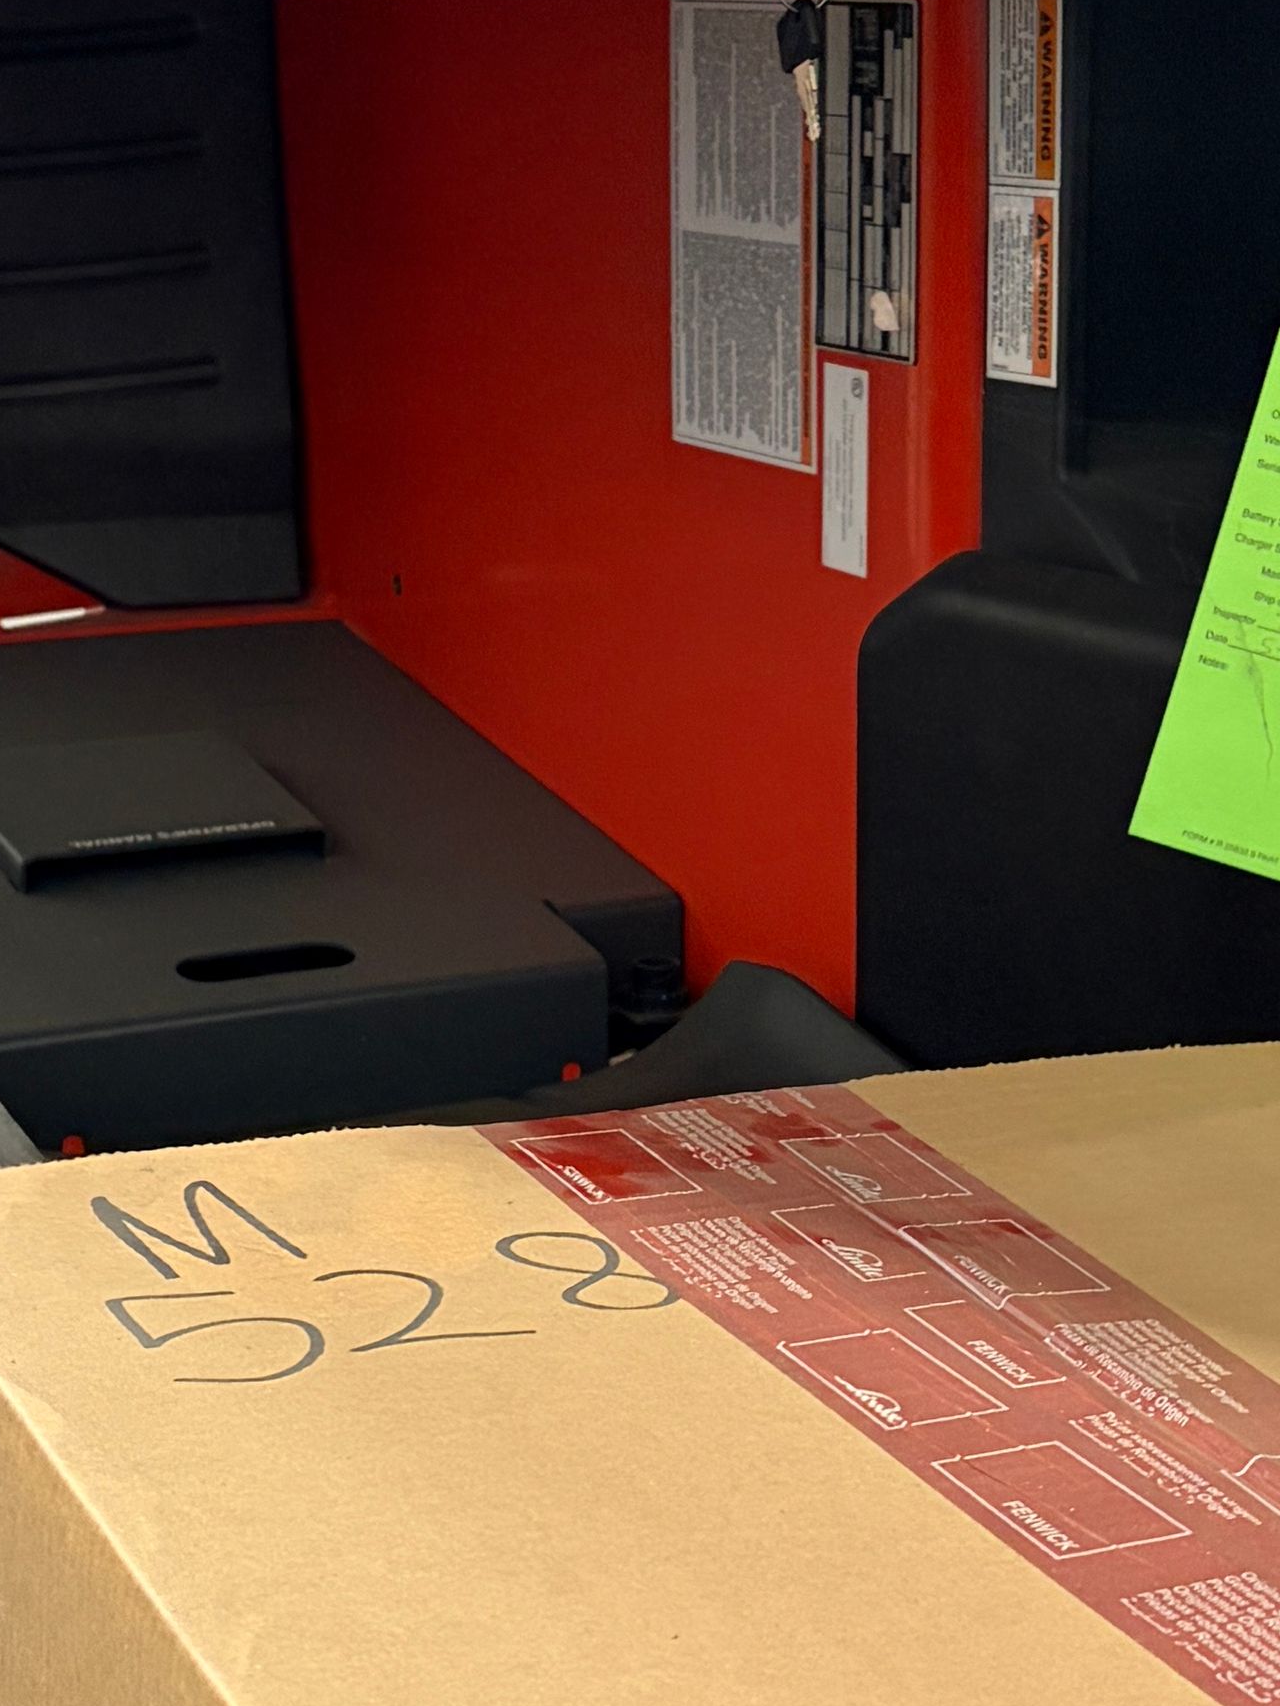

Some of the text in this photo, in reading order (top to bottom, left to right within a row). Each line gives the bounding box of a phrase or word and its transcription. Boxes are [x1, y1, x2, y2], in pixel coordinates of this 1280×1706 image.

[1039, 40, 1054, 162] WARNING
[1035, 242, 1052, 361] WARNING
[1241, 507, 1277, 526] Battery
[1233, 532, 1273, 552] Charger
[1211, 604, 1257, 625] Inspector
[1252, 588, 1276, 604] Ship
[1204, 629, 1229, 645] Date
[90, 1178, 307, 1280] M
[966, 1339, 1037, 1385] FENWICK
[1154, 1395, 1189, 1427] Origen
[1002, 1498, 1081, 1553] FENWICK
[1175, 1619, 1197, 1632] de
[1254, 1676, 1275, 1689] de
